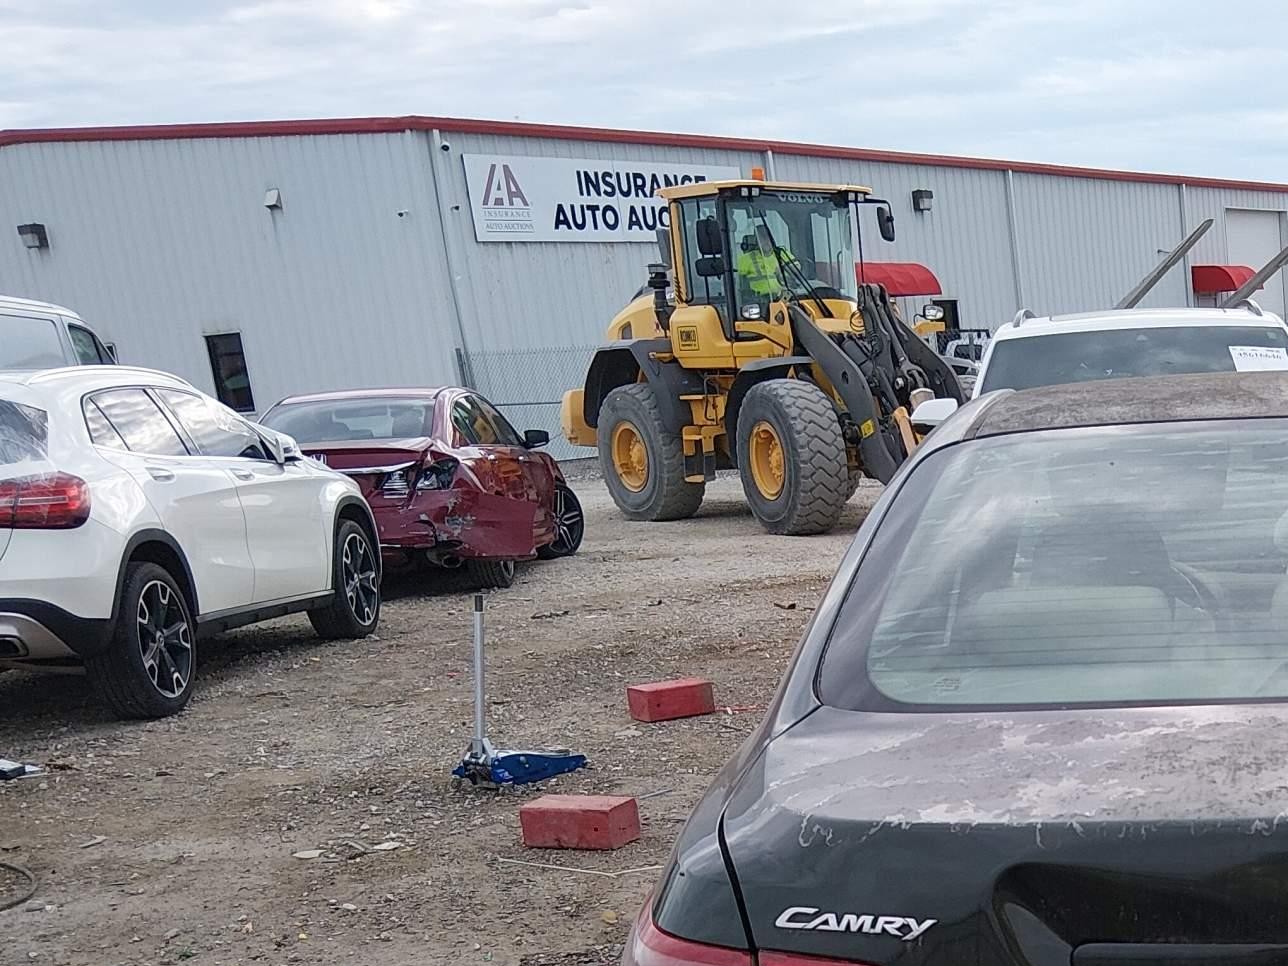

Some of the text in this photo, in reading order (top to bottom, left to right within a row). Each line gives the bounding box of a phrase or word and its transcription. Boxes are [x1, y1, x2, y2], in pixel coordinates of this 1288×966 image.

[778, 193, 823, 203] VOLVO
[554, 203, 619, 231] AUTO
[775, 907, 937, 941] CAMRY
